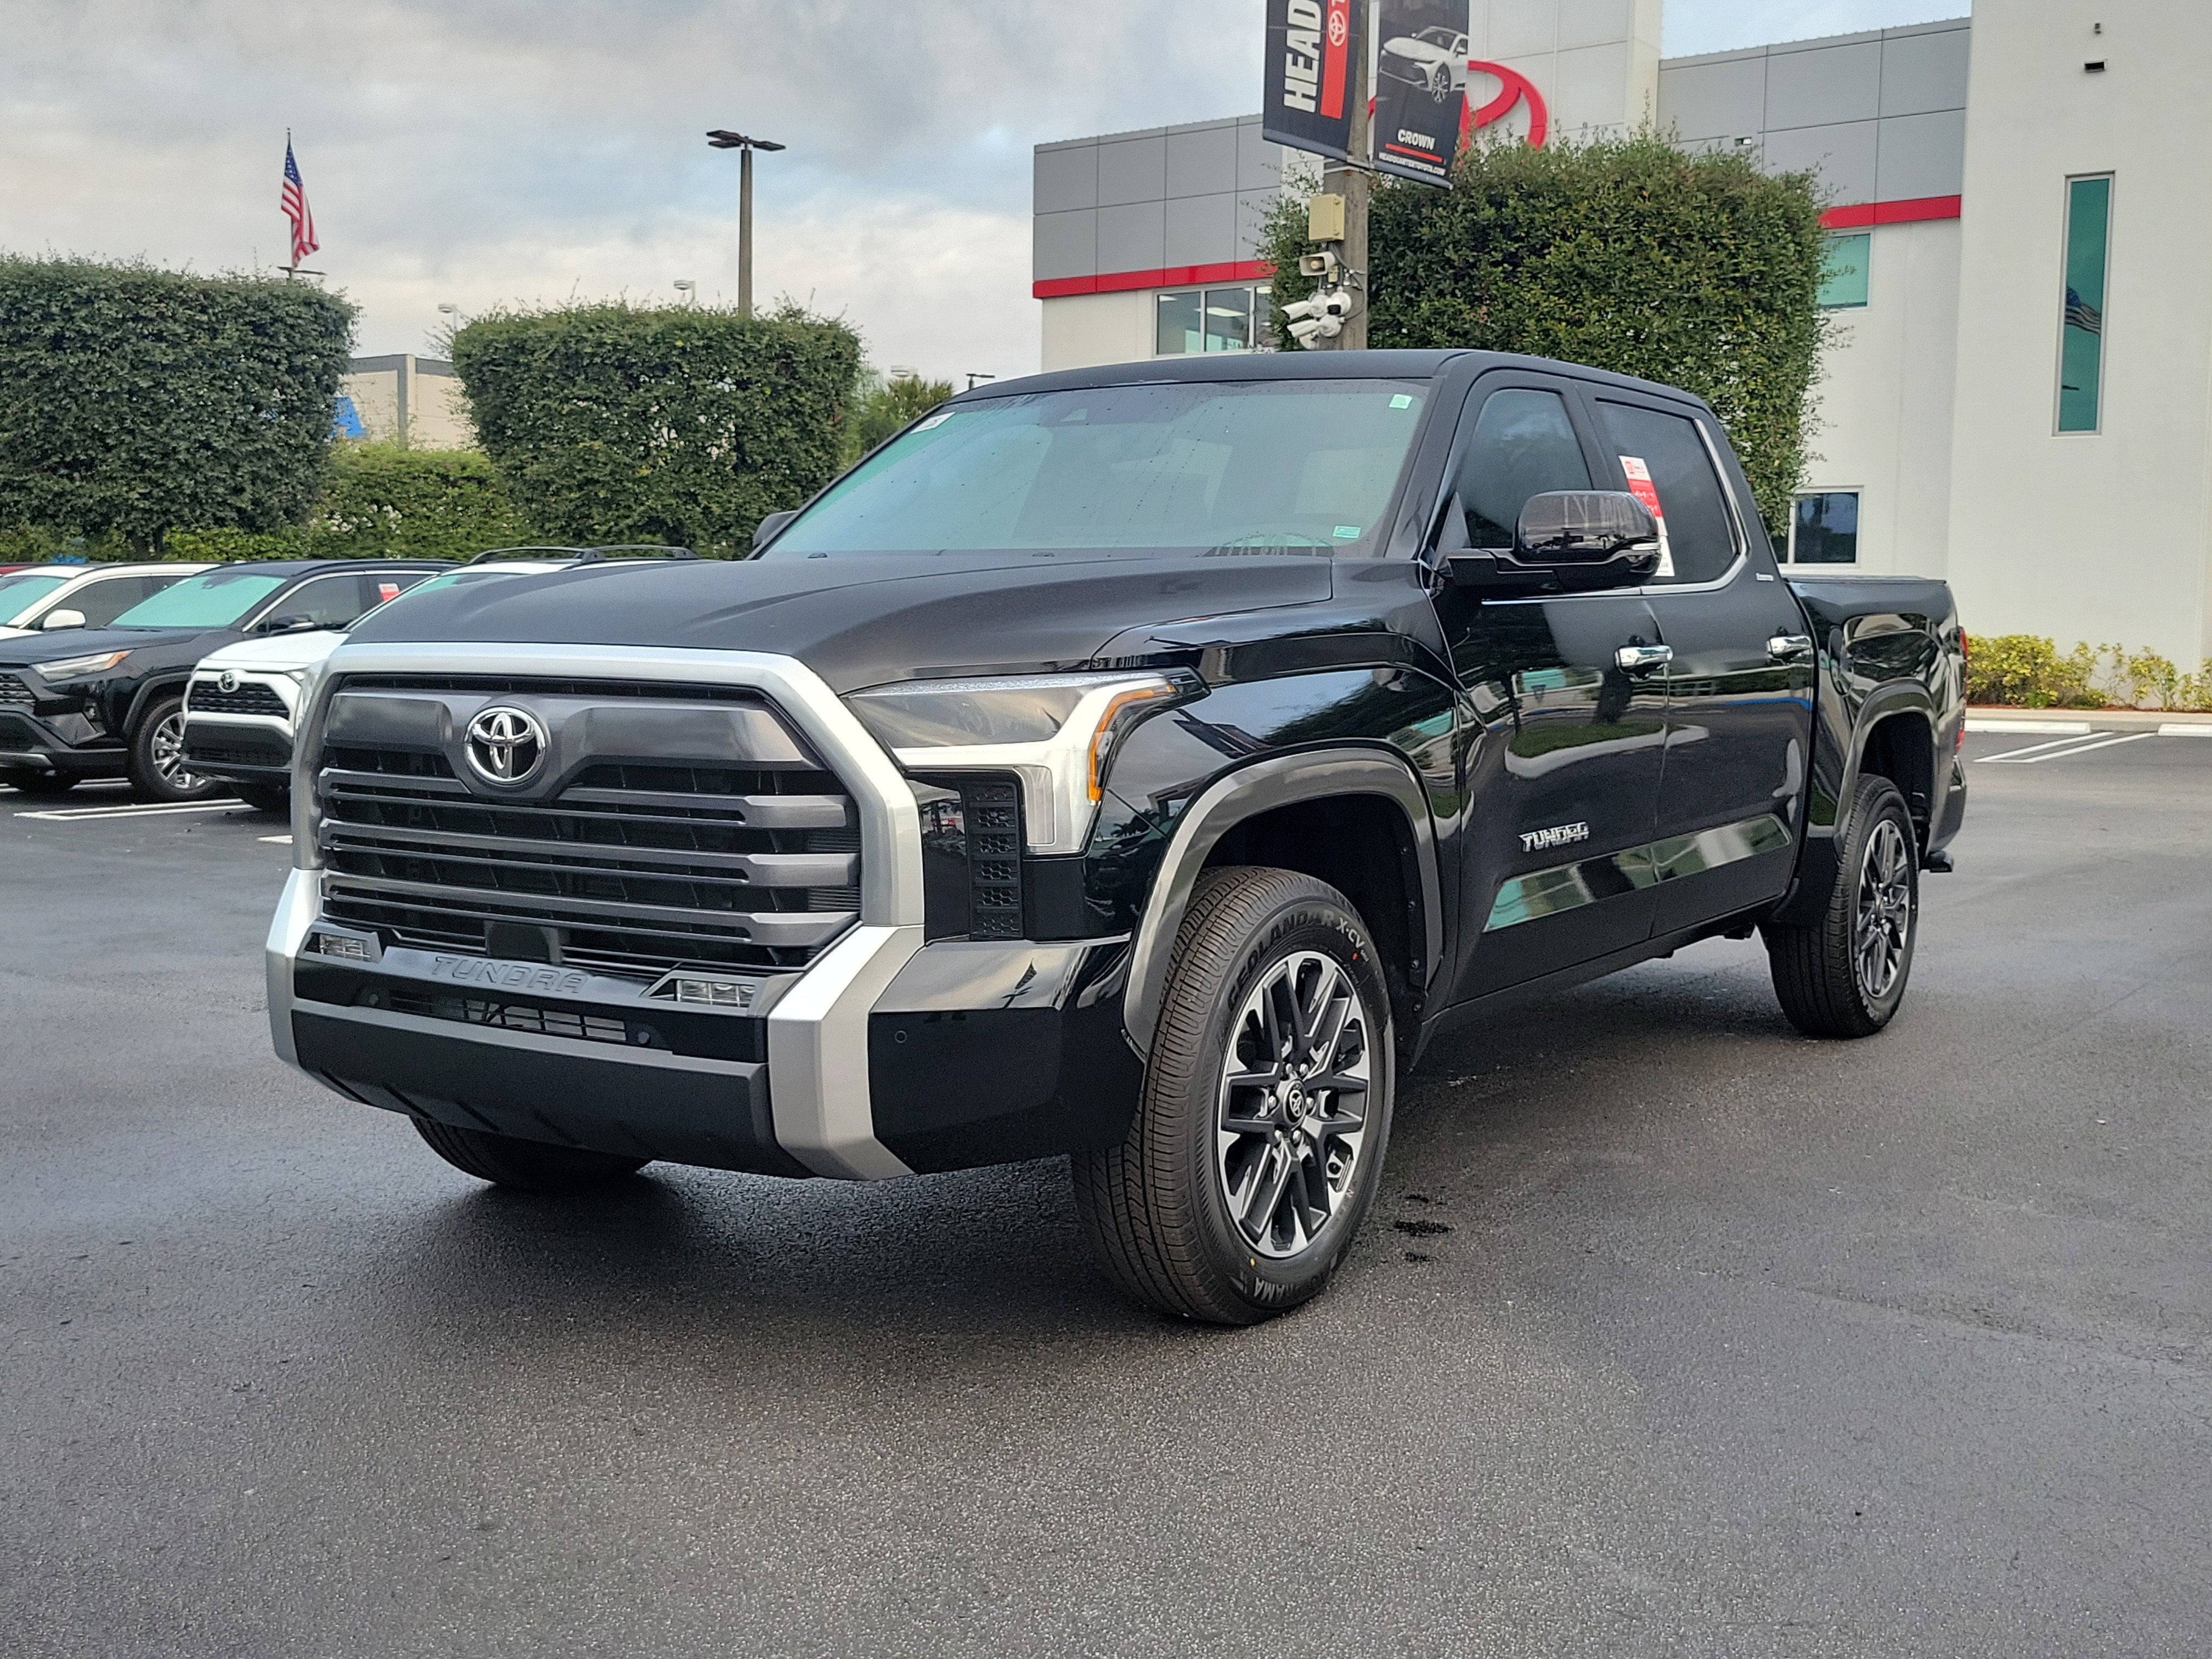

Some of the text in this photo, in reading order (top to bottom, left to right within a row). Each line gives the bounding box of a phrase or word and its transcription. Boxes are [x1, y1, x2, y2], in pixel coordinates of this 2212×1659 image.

[1284, 0, 1322, 113] HEAD
[1397, 129, 1436, 150] CROWN
[432, 956, 588, 994] TUNDRA
